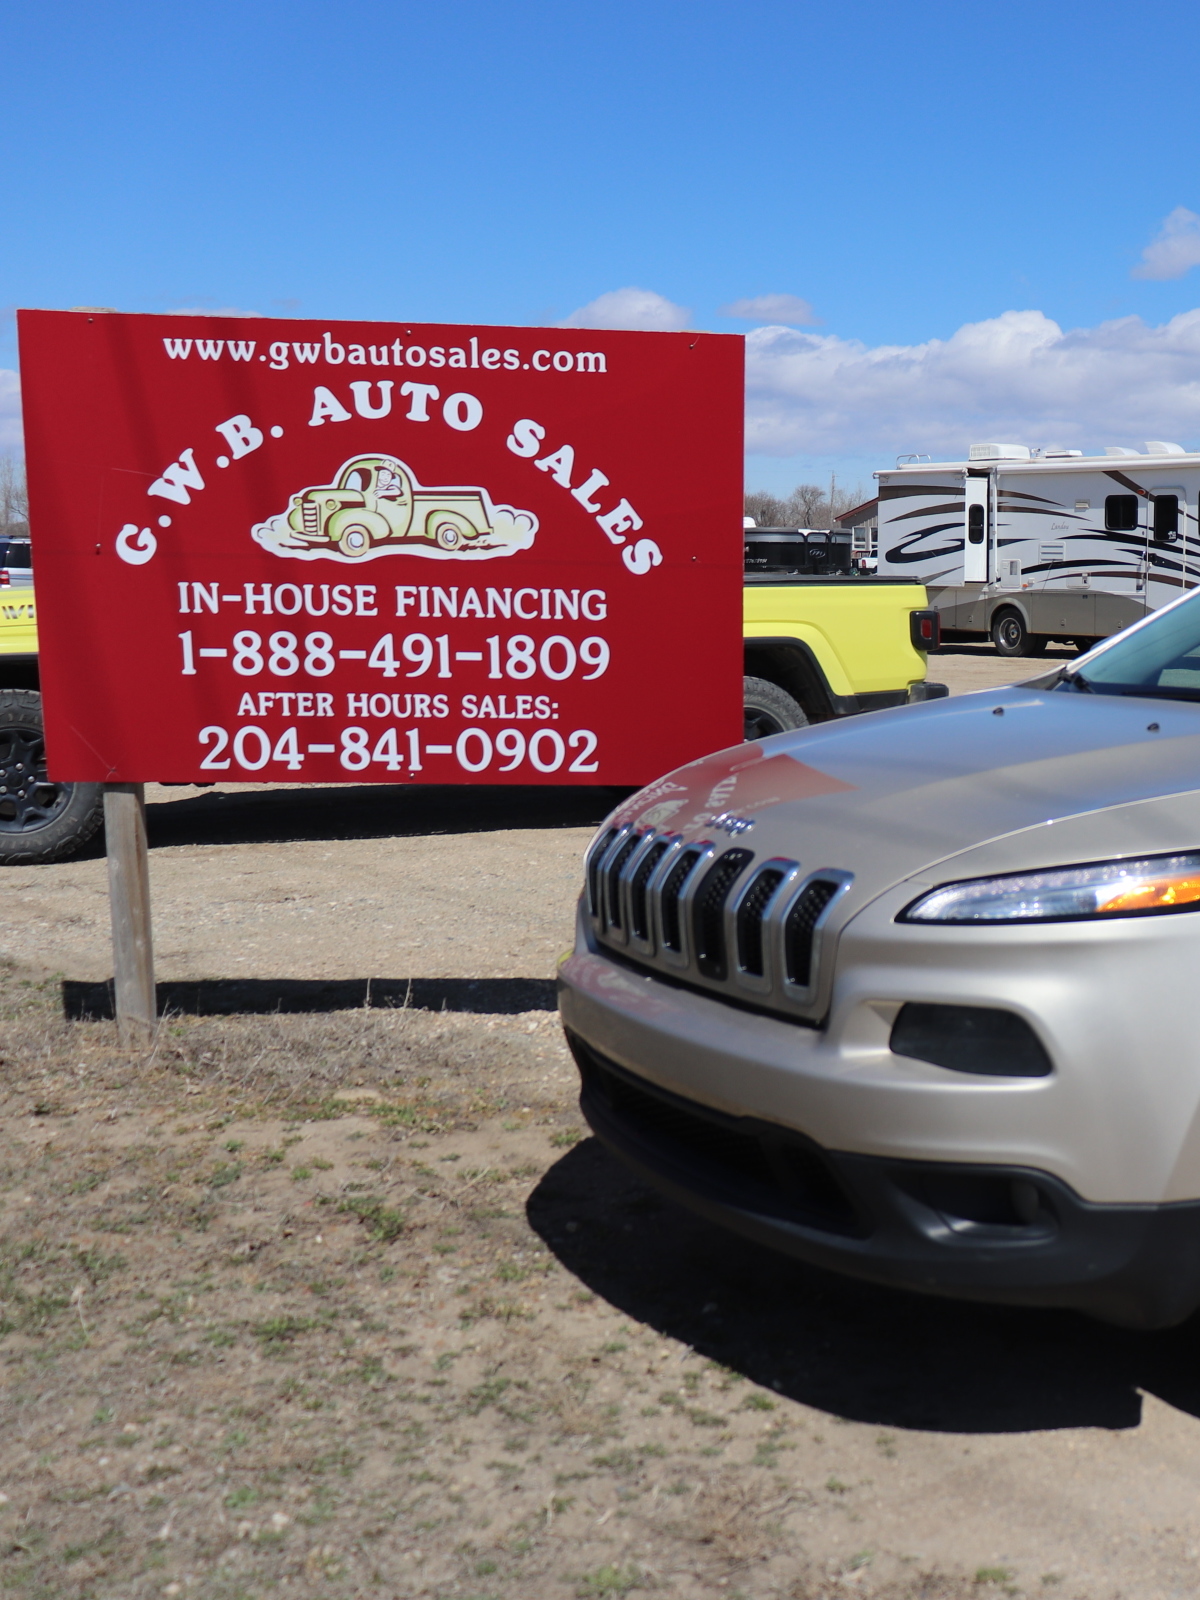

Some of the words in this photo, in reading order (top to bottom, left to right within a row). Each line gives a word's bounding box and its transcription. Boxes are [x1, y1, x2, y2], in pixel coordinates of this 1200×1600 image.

[163, 331, 608, 374] www.gwbautosales.com
[308, 380, 484, 432] AUTO
[507, 418, 664, 576] SALES
[178, 582, 379, 617] IN-HOUSE
[395, 585, 608, 621] FINANCING
[178, 630, 610, 681] 1-888-491-1809
[237, 692, 335, 719] AFTER
[347, 692, 450, 719] HOURS
[462, 694, 560, 720] SALES:
[199, 725, 599, 773] 204-841-0902
